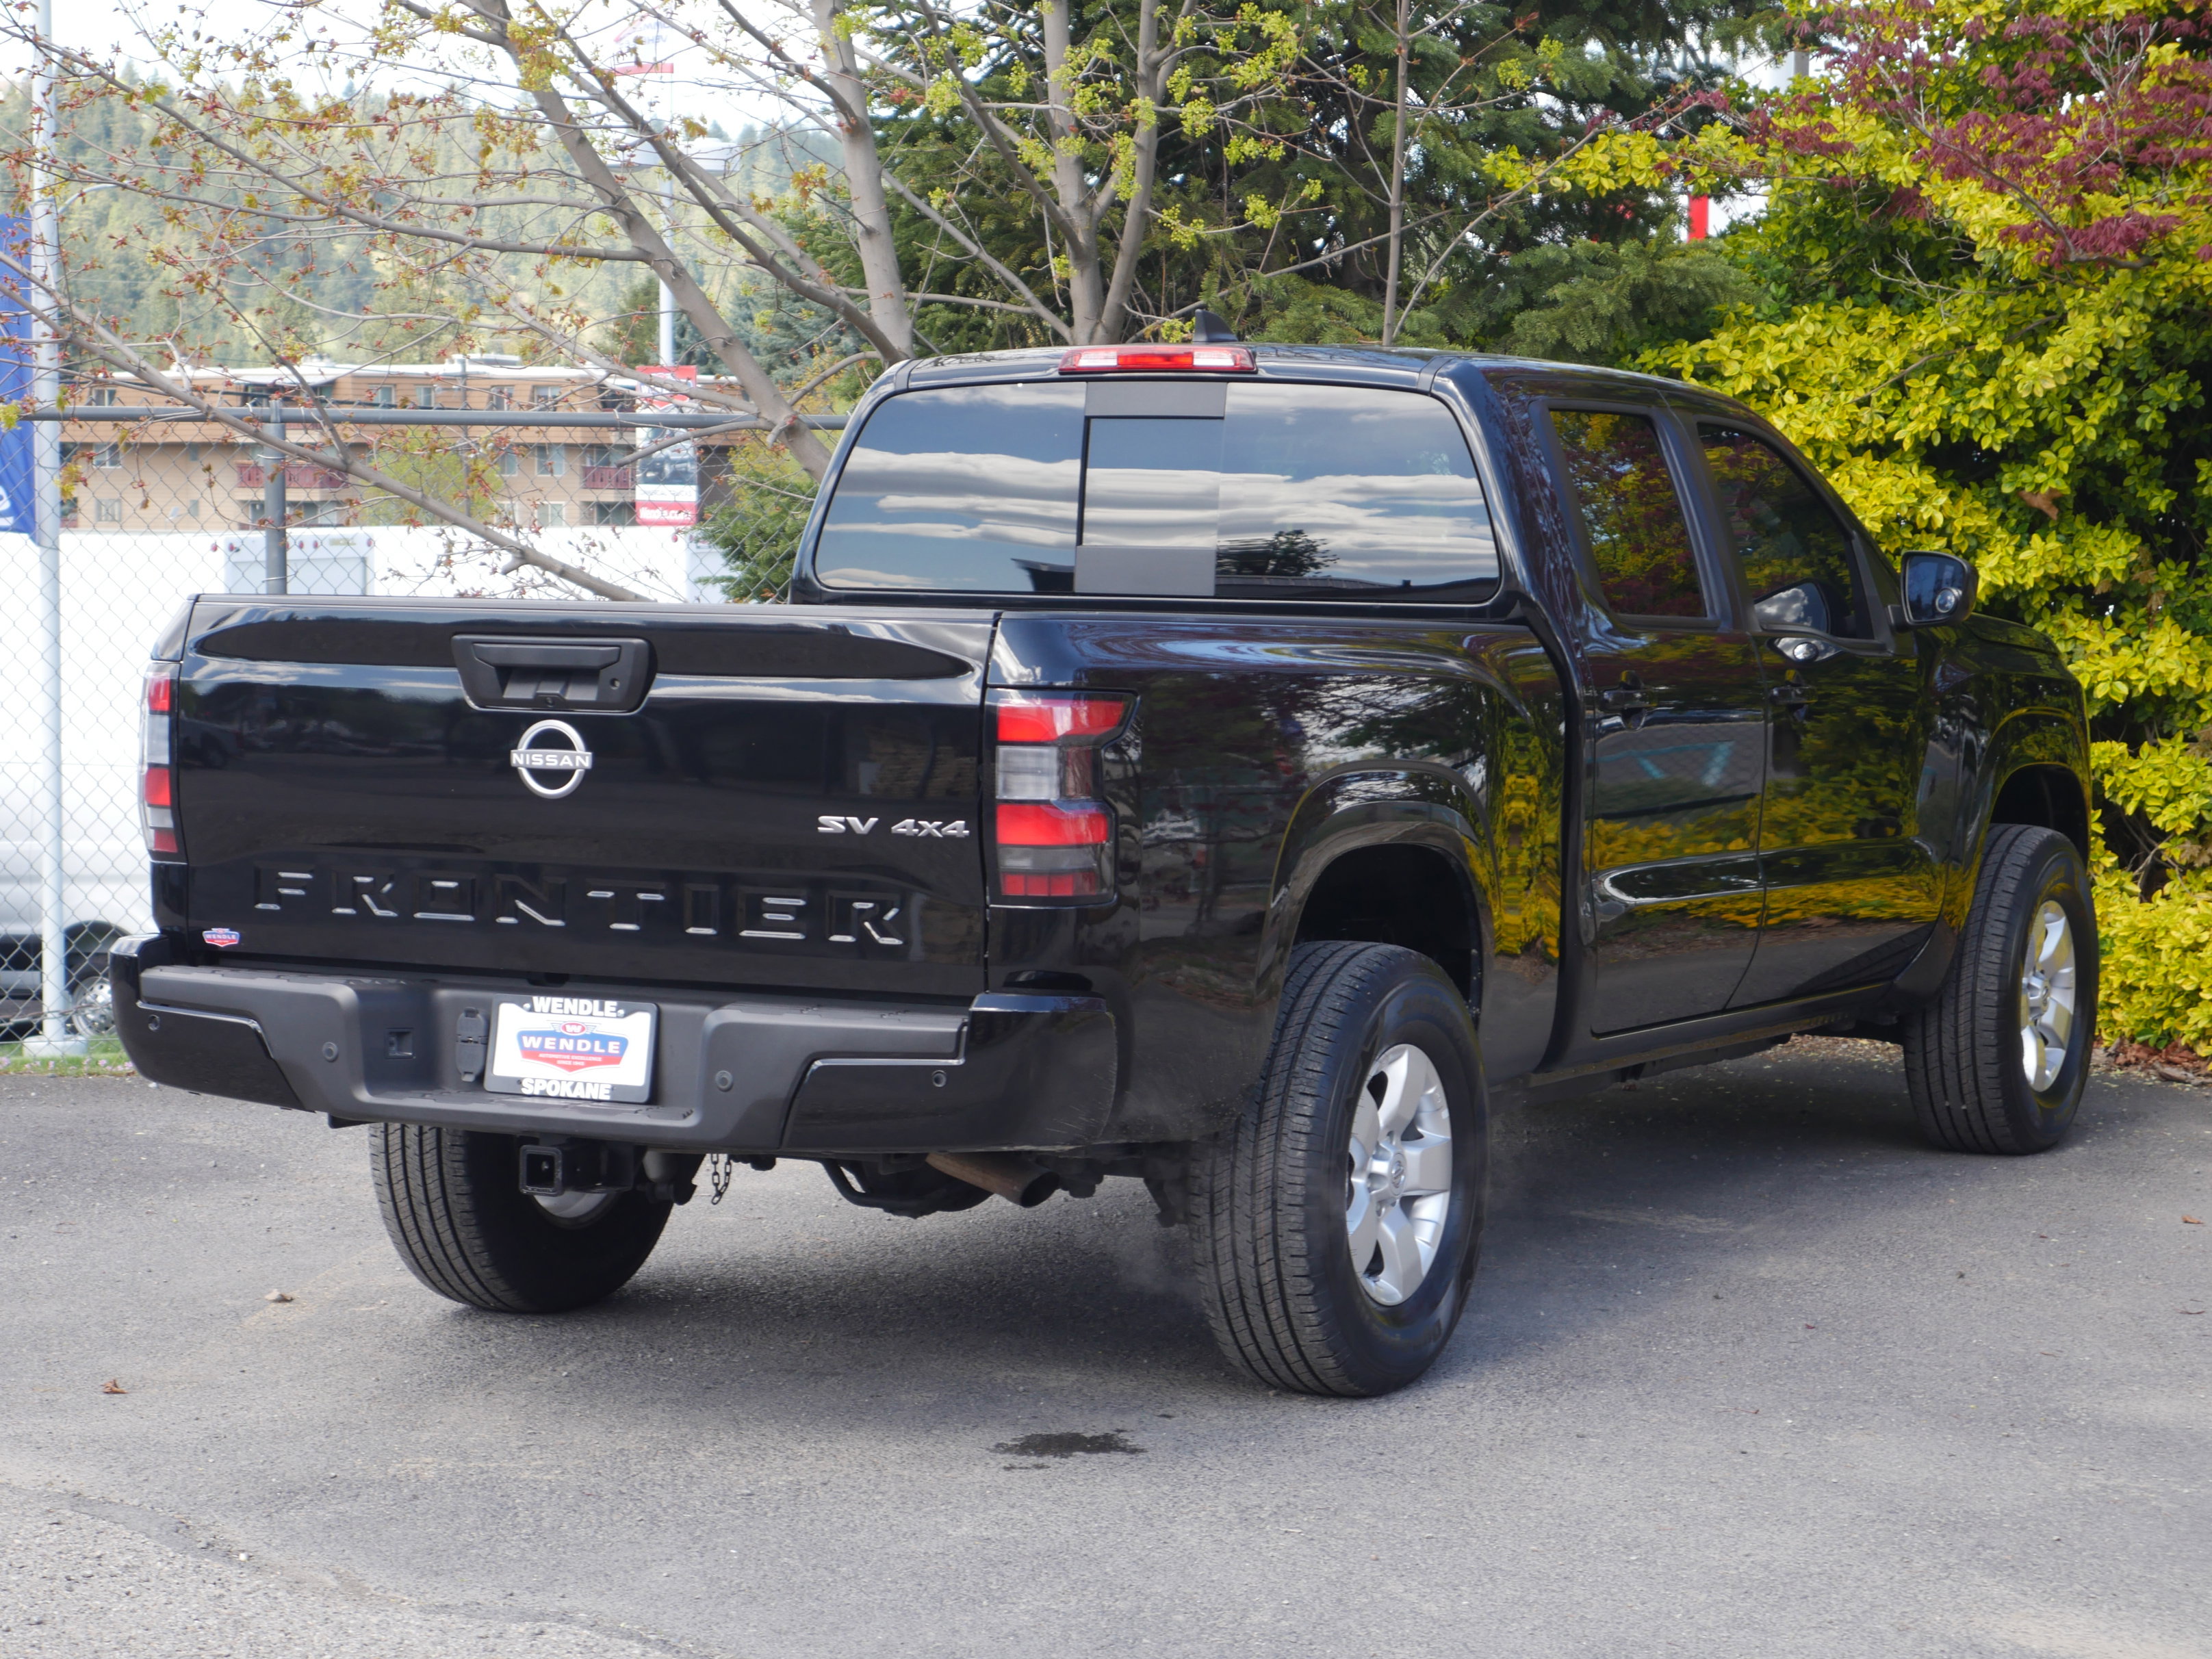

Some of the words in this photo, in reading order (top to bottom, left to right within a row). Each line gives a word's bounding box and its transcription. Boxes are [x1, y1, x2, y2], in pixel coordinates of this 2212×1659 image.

[513, 753, 589, 767] NISSAN
[817, 816, 879, 834] SV
[254, 861, 903, 945] FRONTIER
[532, 996, 618, 1018] WENDLE
[565, 1024, 582, 1033] W
[522, 1036, 621, 1054] WENDLE
[521, 1078, 611, 1100] SPOKANE
